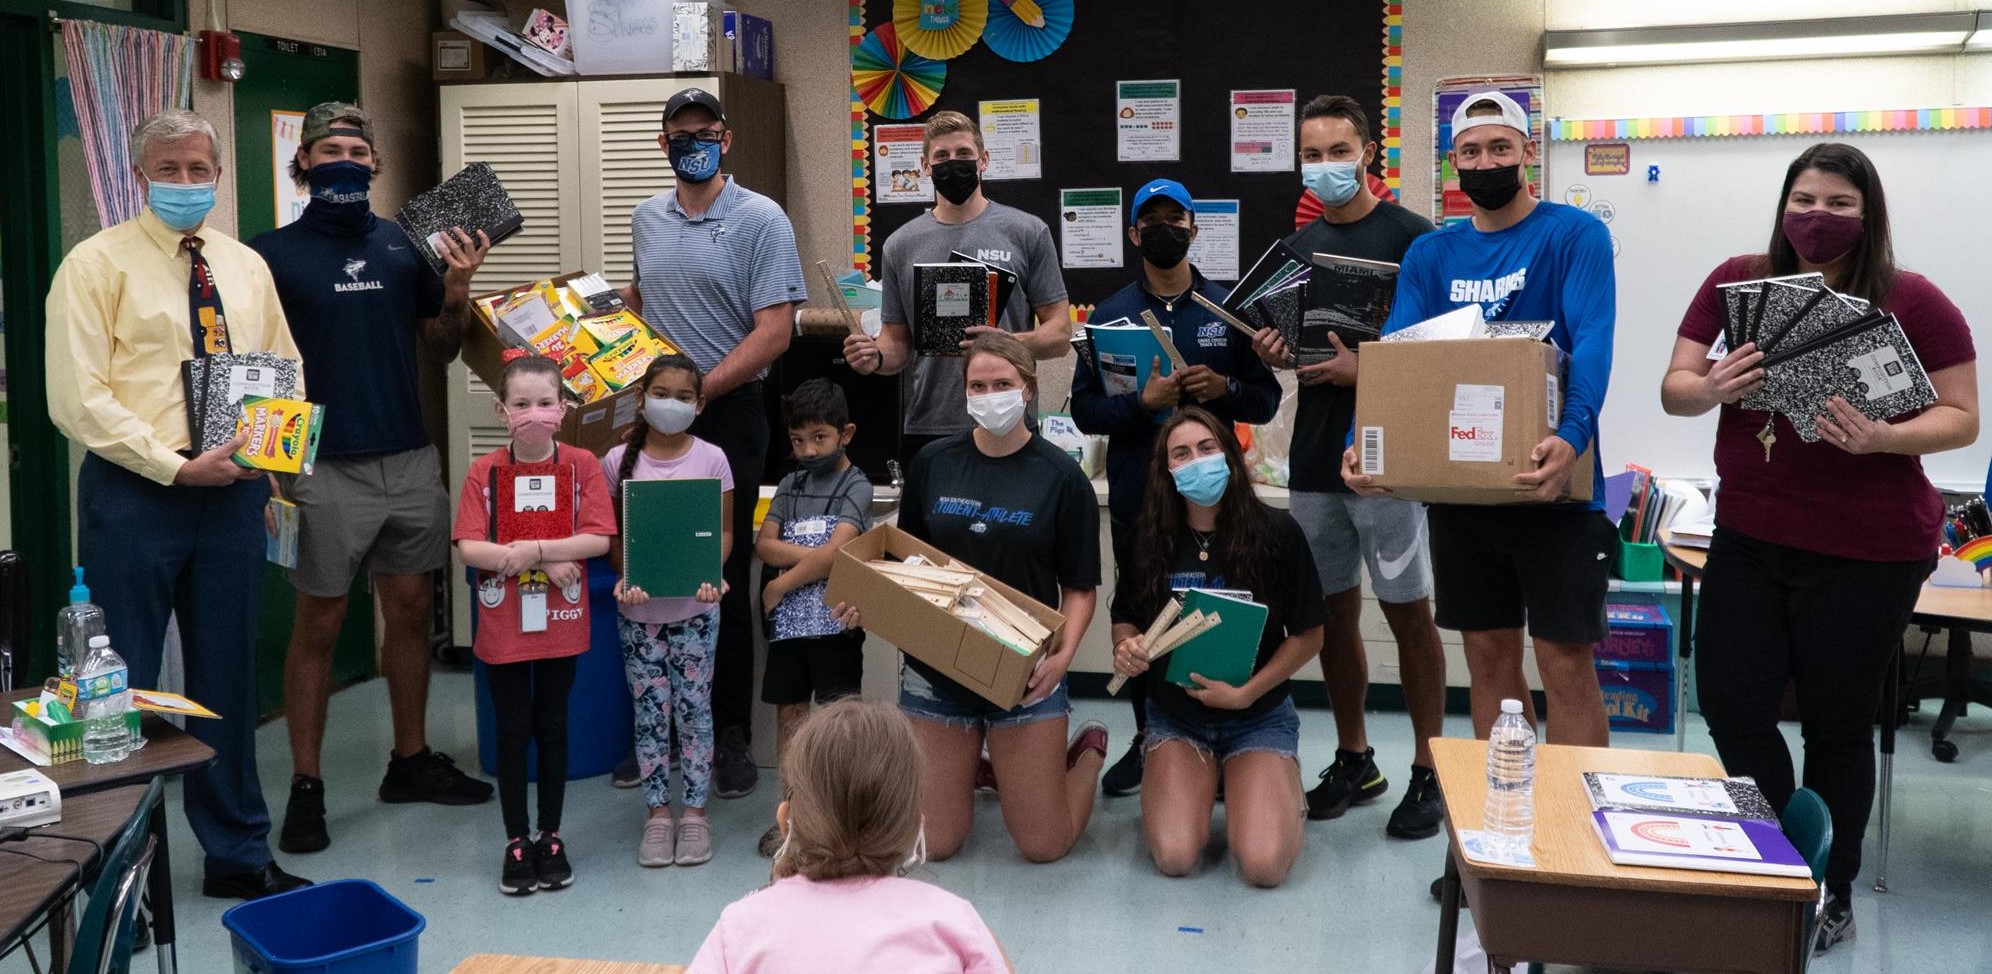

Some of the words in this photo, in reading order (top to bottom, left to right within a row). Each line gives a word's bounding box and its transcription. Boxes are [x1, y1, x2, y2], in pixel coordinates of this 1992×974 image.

[276, 41, 299, 53] TOILET
[678, 156, 711, 175] NSU
[976, 249, 1012, 262] NSU
[334, 281, 384, 292] BASEBALL
[1449, 267, 1527, 303] SHARKS
[1197, 325, 1227, 338] NSU
[1051, 419, 1064, 427] The
[246, 406, 267, 457] MARKERS
[289, 416, 305, 457] Crayola
